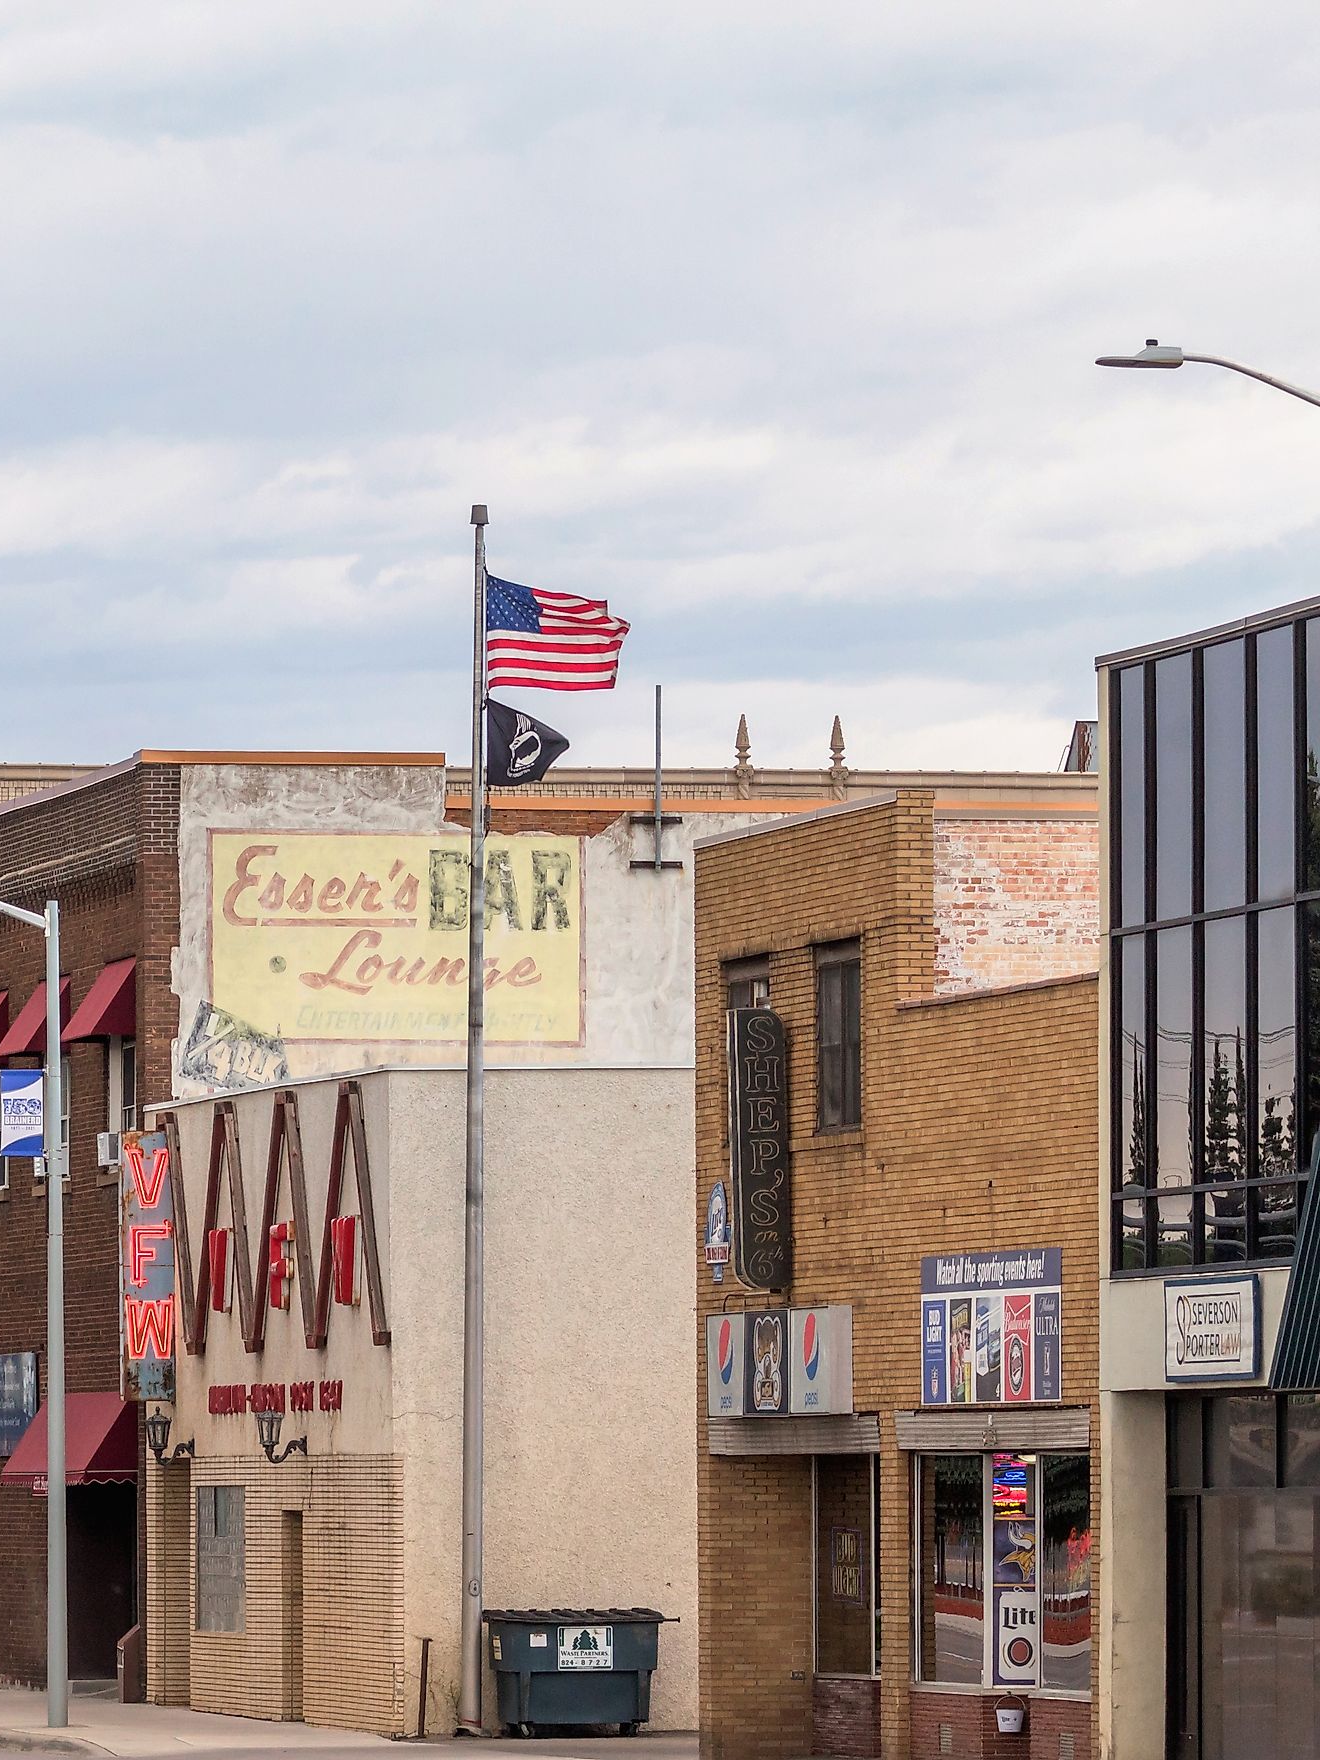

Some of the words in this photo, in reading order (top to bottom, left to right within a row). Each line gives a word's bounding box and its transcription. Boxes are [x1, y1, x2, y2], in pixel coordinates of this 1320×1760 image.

[222, 844, 421, 927] Esser's
[428, 848, 573, 932] BAR
[5, 1116, 41, 1125] BRAINERD
[745, 1016, 784, 1227] SHEP'S
[124, 1144, 173, 1360] VFW
[754, 1229, 779, 1244] on
[749, 1245, 784, 1281] 6th
[936, 1258, 956, 1286] Watch
[956, 1257, 964, 1284] all
[964, 1256, 977, 1282] the
[977, 1254, 1005, 1287] sporting
[1005, 1255, 1026, 1281] events
[1026, 1251, 1045, 1280] here!
[1036, 1315, 1059, 1336] ULTRA
[1192, 1301, 1238, 1325] SEVERSON
[926, 1326, 943, 1343] LIGHT
